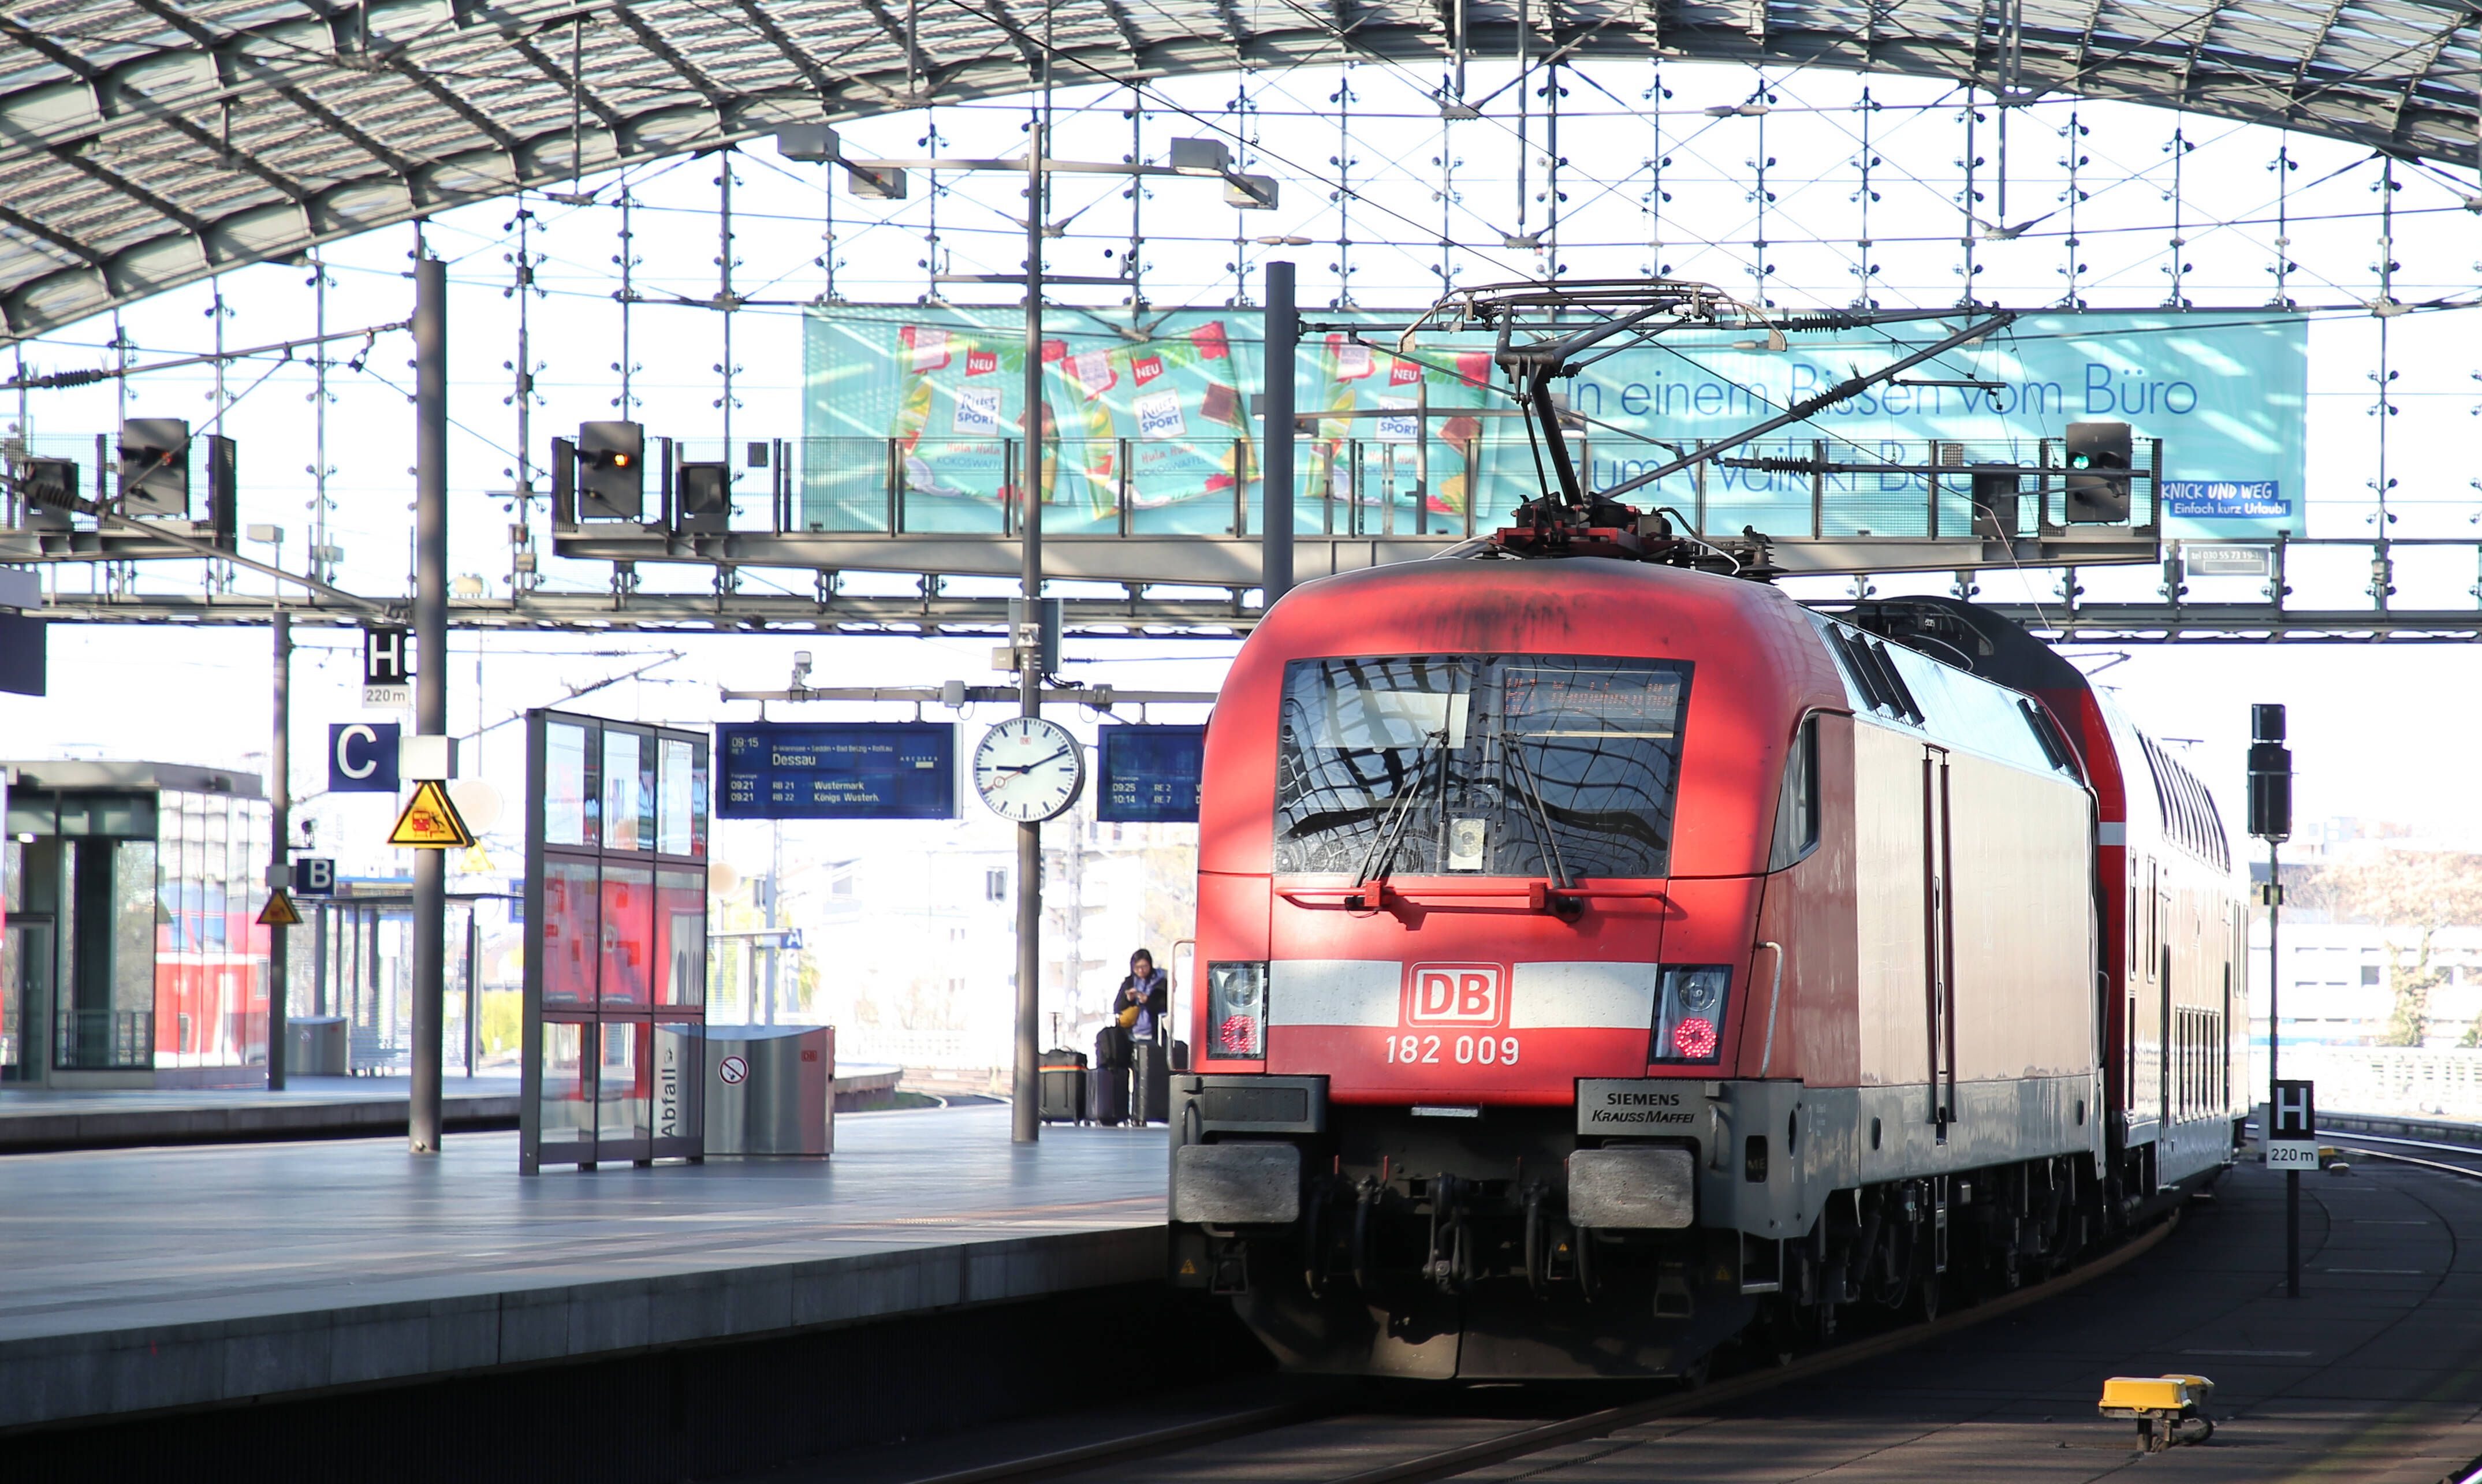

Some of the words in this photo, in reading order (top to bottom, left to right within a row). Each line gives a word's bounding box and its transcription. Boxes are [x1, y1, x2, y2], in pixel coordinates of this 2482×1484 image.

[969, 357, 993, 371] NEU
[1135, 363, 1160, 379] NEU
[1393, 368, 1417, 381] NEU
[1622, 370, 1769, 415] einem
[1959, 381, 2063, 415] vom
[2086, 363, 2198, 415] Büro
[1142, 415, 1179, 433] SPORT
[1380, 422, 1418, 435] SPORT
[1570, 460, 1661, 492] um
[1677, 436, 1857, 491] Waikki
[2207, 483, 2238, 501] UND
[2241, 482, 2273, 499] WEG
[2174, 503, 2214, 514] Einfach
[2218, 503, 2242, 514] kurz
[370, 633, 398, 676] H
[366, 690, 390, 702] 220
[393, 692, 405, 701] m
[732, 737, 759, 748] 09:15
[337, 724, 378, 780] C
[773, 753, 816, 766] Dessau
[785, 781, 794, 789] 21
[814, 781, 864, 790] Wustermark
[1113, 783, 1136, 792] 09:25
[1154, 784, 1164, 792] RE
[785, 793, 794, 801] 22
[814, 792, 840, 803] Königs
[844, 793, 879, 802] Wusterh.
[1113, 795, 1135, 803] 10:14
[1154, 795, 1164, 803] RE
[310, 860, 331, 889] B
[1421, 974, 1490, 1016] DB
[1386, 1035, 1441, 1064] 182
[1455, 1036, 1519, 1065] 009
[661, 1068, 676, 1138] Abfall
[1607, 1093, 1680, 1106] SIEMENS
[2277, 1087, 2307, 1130] H
[2271, 1149, 2298, 1161] 220
[2300, 1152, 2314, 1161] m
